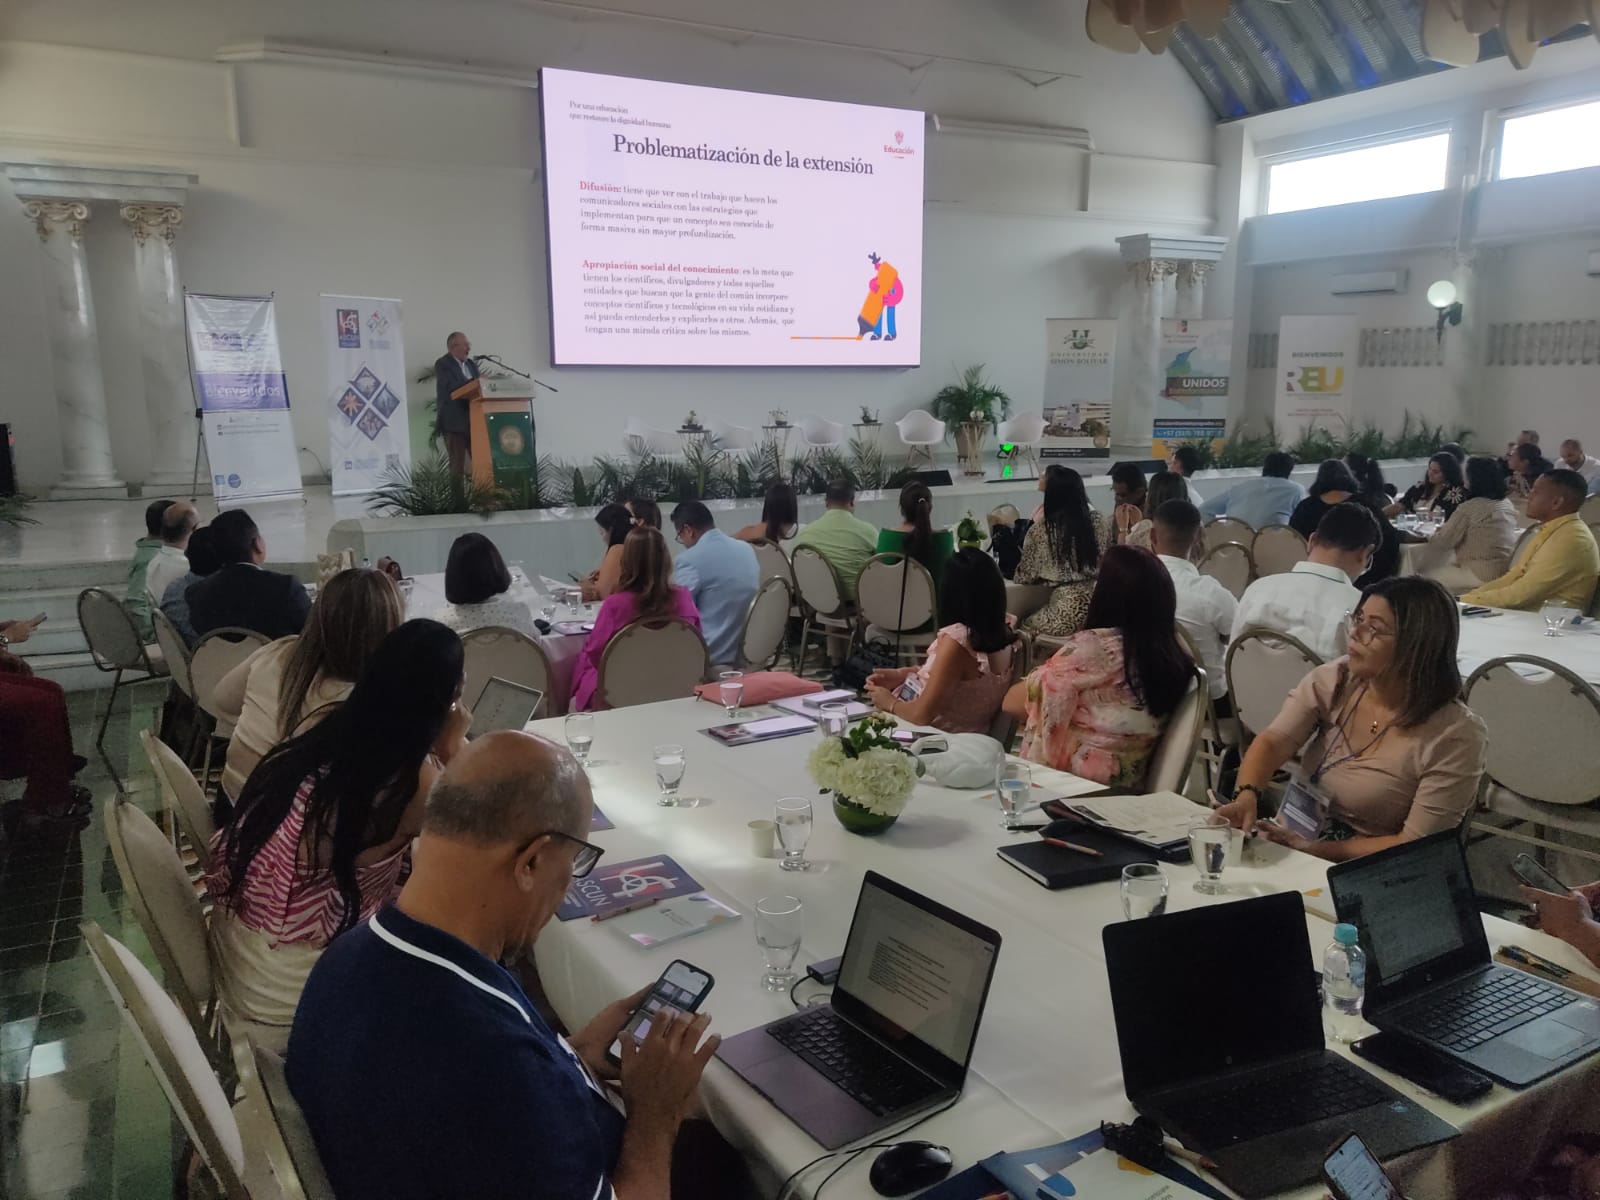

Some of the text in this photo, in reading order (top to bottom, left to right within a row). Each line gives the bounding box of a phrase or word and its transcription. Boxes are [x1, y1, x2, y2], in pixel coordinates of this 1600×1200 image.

[613, 133, 874, 175] Problematización de la extensión
[883, 144, 915, 156] Educación
[580, 180, 621, 193] Difusión:
[624, 184, 643, 194] tiene
[645, 188, 660, 198] que
[692, 190, 698, 199] el
[700, 192, 728, 203] trabajo
[728, 196, 742, 204] que
[744, 194, 766, 204] hacen
[768, 196, 778, 204] los
[580, 196, 640, 208] comunicadores
[642, 200, 672, 210] sociales
[689, 202, 700, 212] las
[702, 205, 743, 215] estrategias
[744, 208, 758, 216] que
[580, 208, 635, 220] implementan
[636, 214, 655, 224] para
[656, 216, 670, 224] que
[672, 216, 683, 224] un
[684, 218, 718, 228] concepto
[765, 221, 774, 230] de
[581, 221, 606, 232] forma
[608, 224, 636, 233] masiva
[638, 226, 650, 234] sin
[652, 228, 677, 238] mayor
[640, 262, 666, 272] social
[668, 264, 681, 272] del
[752, 267, 760, 276] la
[780, 270, 794, 278] que
[583, 272, 608, 282] tienen
[611, 273, 622, 282] los
[667, 276, 715, 286] divulgadores
[584, 286, 788, 302] entidades que buscan que la gente del común incorpore
[584, 300, 622, 310] conceptos
[624, 300, 664, 310] científicos
[672, 302, 716, 312] tecnológicos
[739, 304, 754, 312] vida
[756, 304, 788, 314] cotidiana
[598, 312, 622, 322] pueda
[624, 314, 670, 322] entenderlos
[672, 316, 676, 324] y
[678, 314, 718, 324] explicarlos
[782, 318, 794, 326] que
[584, 326, 613, 335] tengan
[632, 326, 660, 334] mirada
[688, 327, 707, 335] sobre
[709, 327, 720, 336] los
[1182, 378, 1226, 388] UNIDOS
